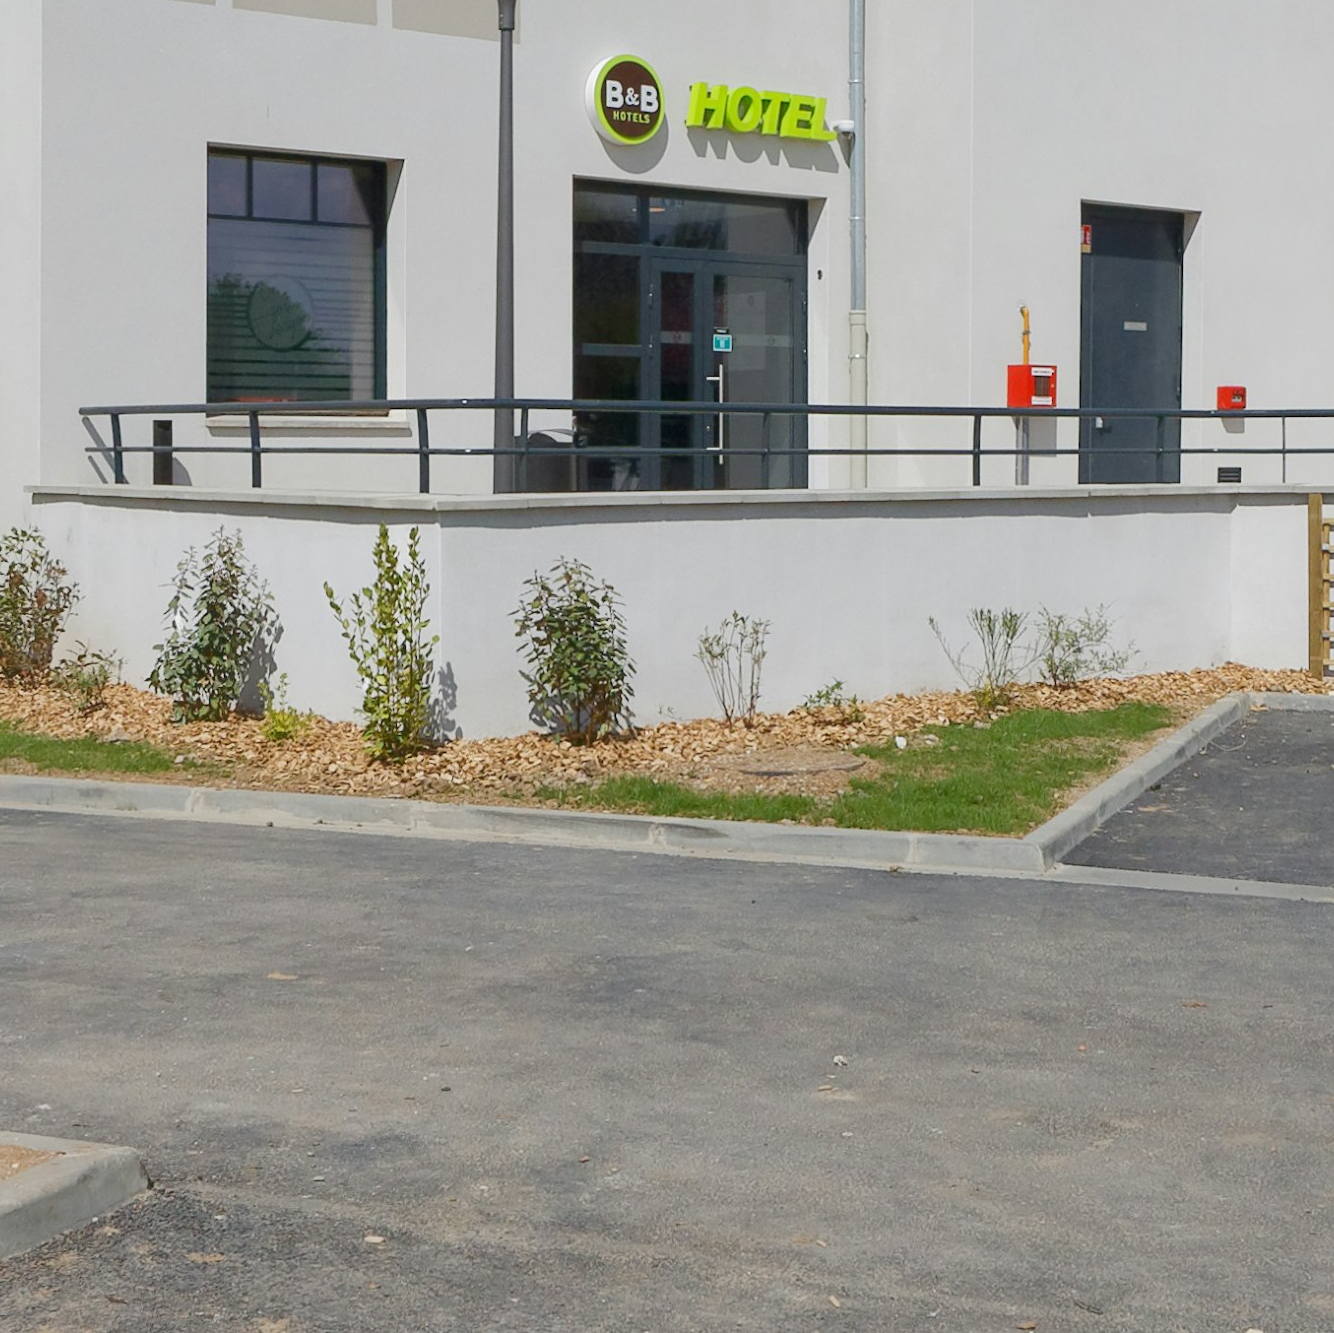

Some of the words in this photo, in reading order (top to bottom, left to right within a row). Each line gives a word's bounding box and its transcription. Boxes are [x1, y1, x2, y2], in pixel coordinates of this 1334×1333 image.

[605, 79, 659, 113] B&B
[686, 82, 837, 141] HOTEL
[613, 110, 651, 124] HOTELS
